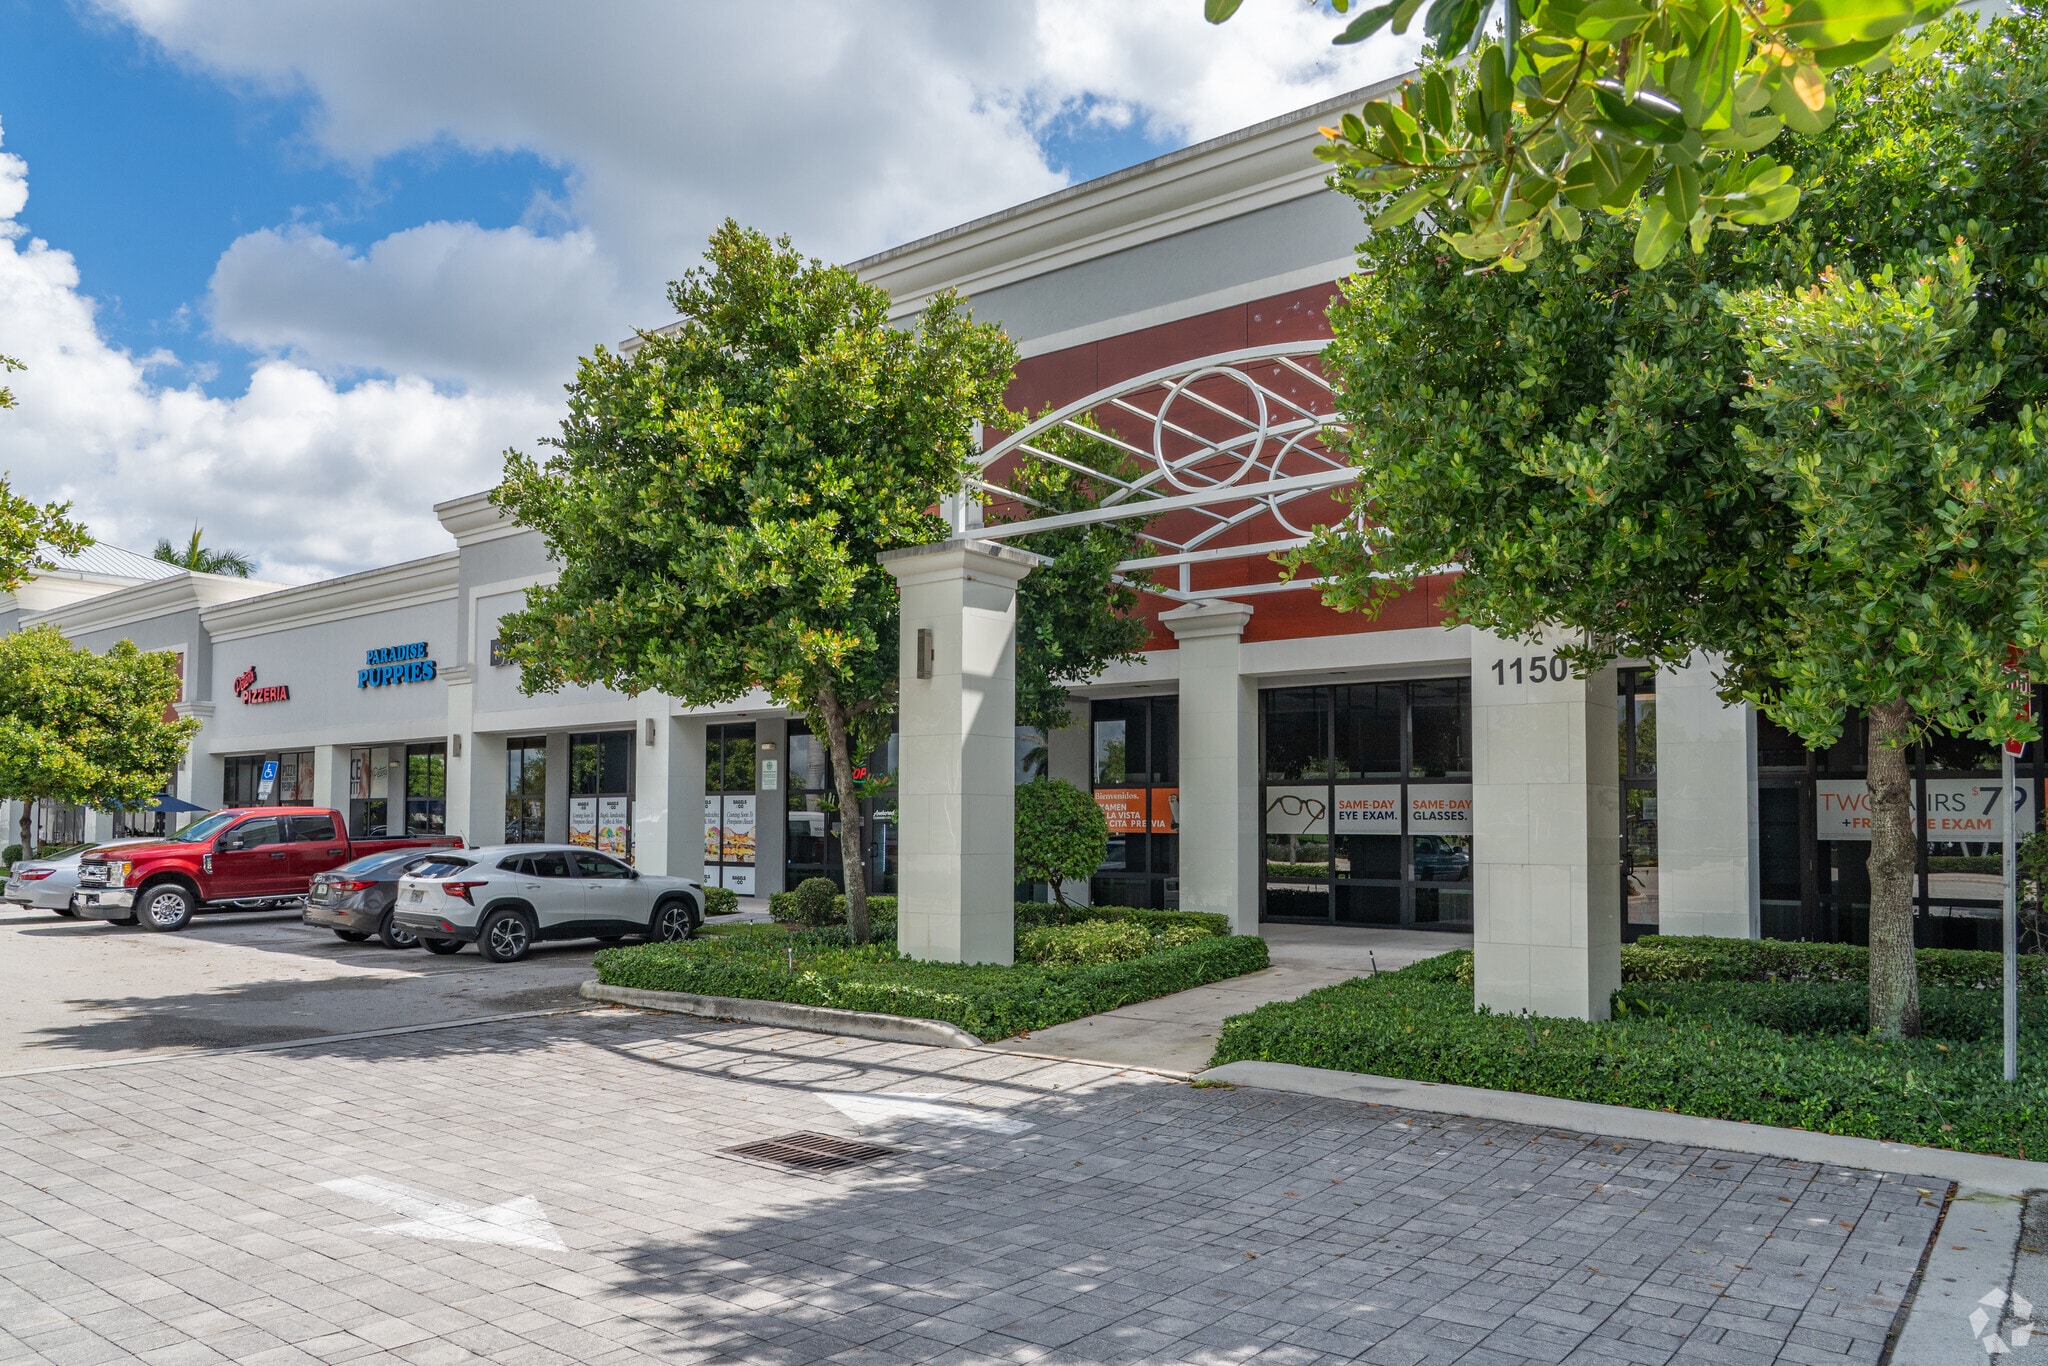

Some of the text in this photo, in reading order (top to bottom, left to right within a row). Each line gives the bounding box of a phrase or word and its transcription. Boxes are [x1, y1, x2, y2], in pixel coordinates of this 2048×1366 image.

[366, 641, 428, 665] PARADISE
[358, 660, 437, 689] PUPPIES
[1491, 655, 1568, 685] 1150
[242, 685, 290, 704] PIZZERIA
[853, 767, 867, 780] OP
[1095, 792, 1140, 800] Bienvenidos.
[1339, 800, 1395, 809] SAME-DAY
[1412, 800, 1473, 809] SAME-DAY
[1339, 811, 1398, 820] EYE EXAM.
[1413, 811, 1468, 820] GLASSES.
[1842, 817, 1872, 830] +FR
